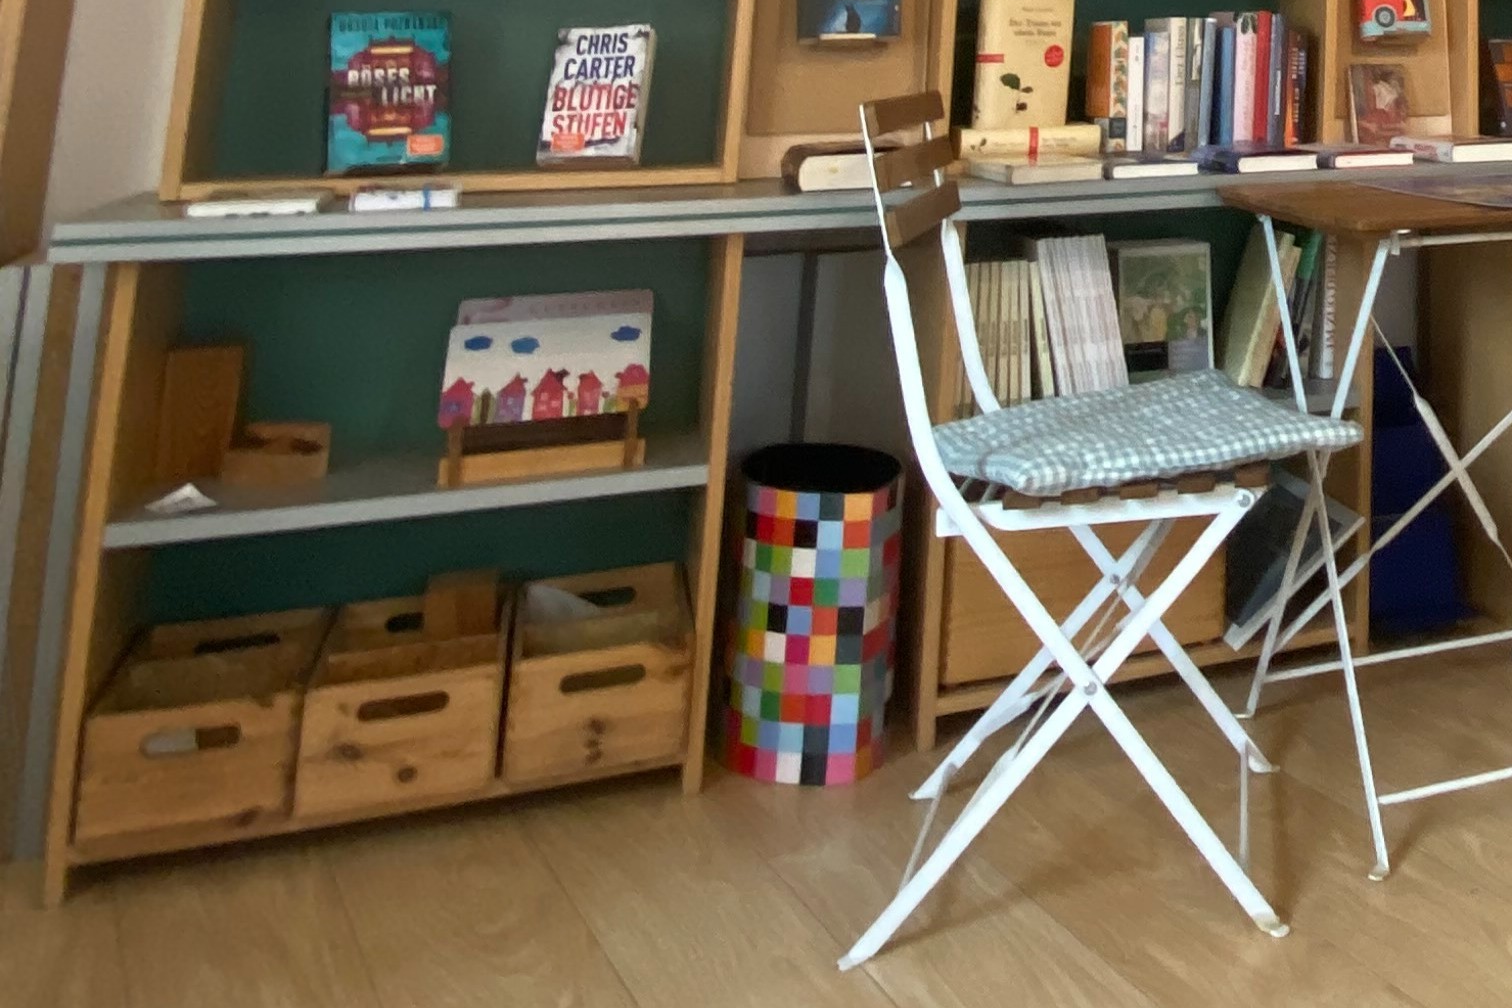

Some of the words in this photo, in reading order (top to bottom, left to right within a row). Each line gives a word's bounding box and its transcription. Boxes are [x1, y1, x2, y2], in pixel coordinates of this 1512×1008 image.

[576, 32, 629, 56] CHRIS
[563, 54, 636, 81] CARTER
[380, 84, 438, 107] LICHT
[551, 81, 640, 113] BLUTIGE
[551, 111, 628, 138] STUFEN
